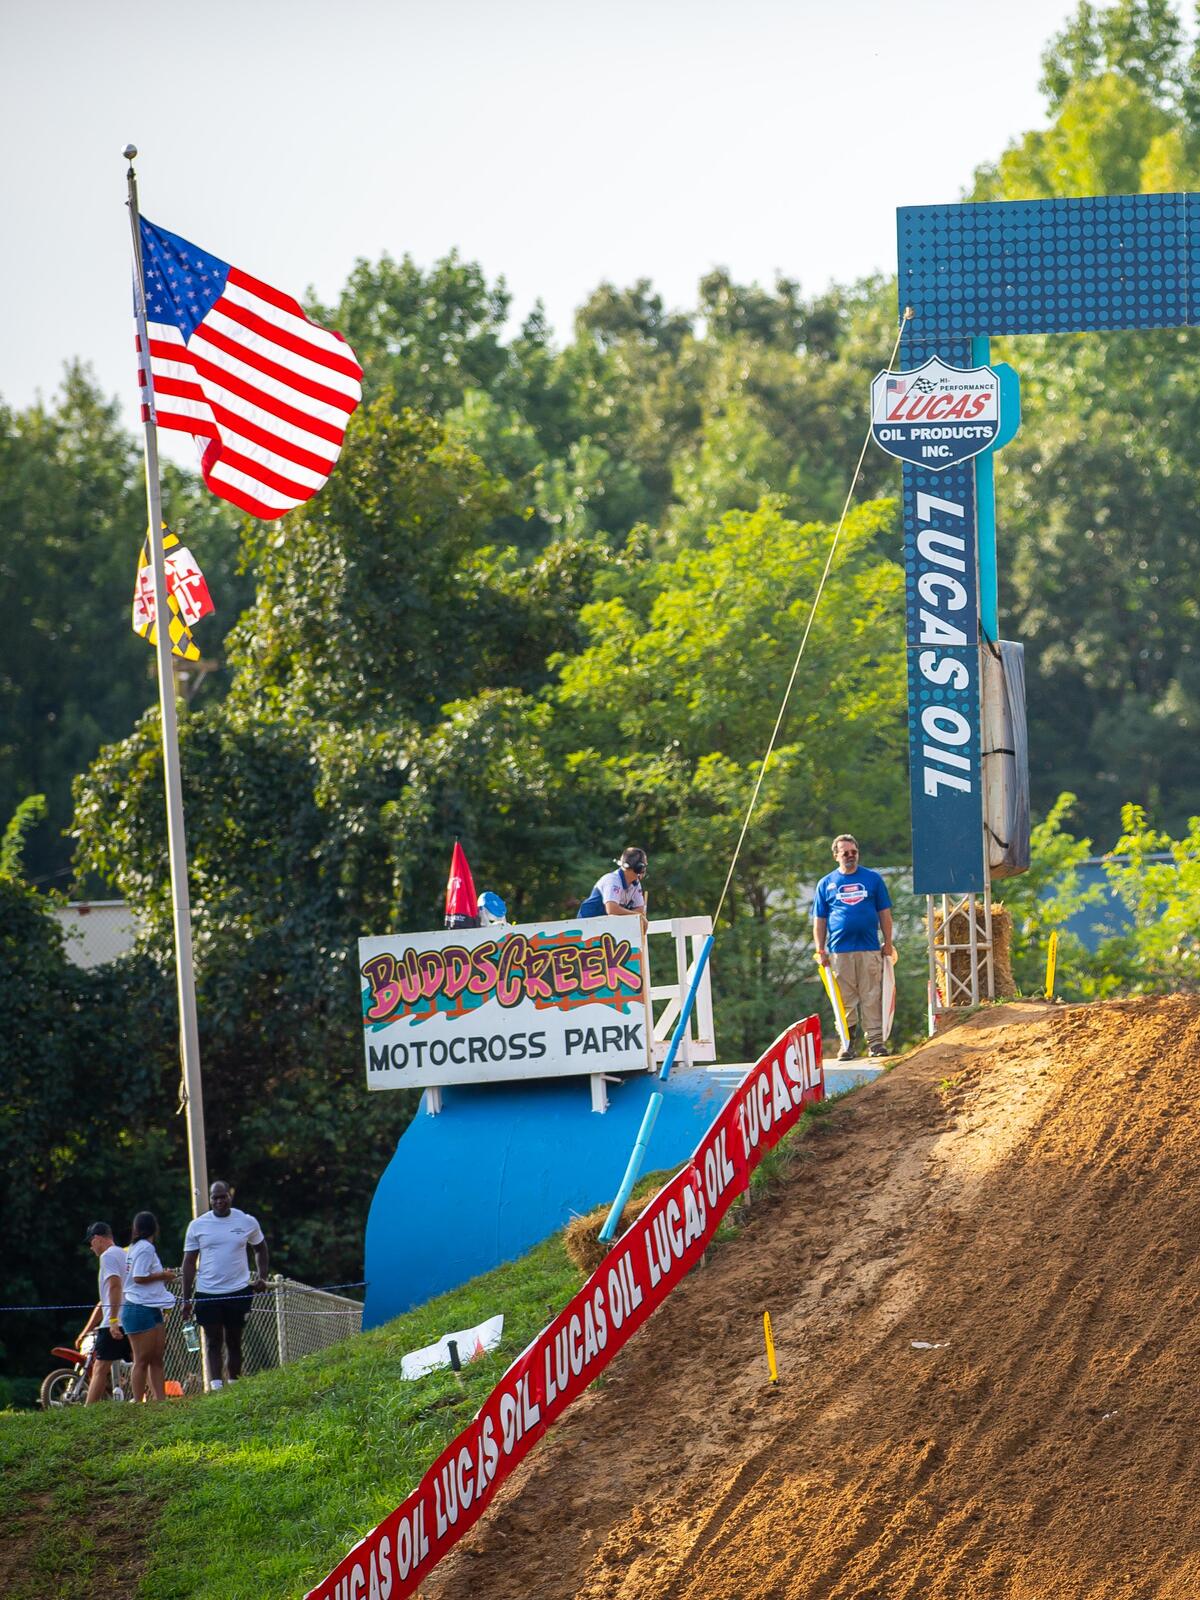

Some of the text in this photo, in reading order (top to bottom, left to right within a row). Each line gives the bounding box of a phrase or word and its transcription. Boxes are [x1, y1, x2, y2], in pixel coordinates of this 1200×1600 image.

[939, 384, 995, 392] PERFORMANCE
[886, 393, 992, 421] LUCAS
[879, 426, 994, 441] OIL PRODUCTS
[921, 445, 953, 458] INC.
[916, 491, 972, 798] LUCAS OIL
[368, 1023, 643, 1072] MOTOCROSS PARK
[397, 1499, 430, 1580] OIL
[433, 1415, 499, 1540] LUCAS
[499, 1371, 541, 1455] OIL
[544, 1286, 608, 1407] LUCAS
[607, 1251, 643, 1329] OIL
[704, 1127, 735, 1208] OIL
